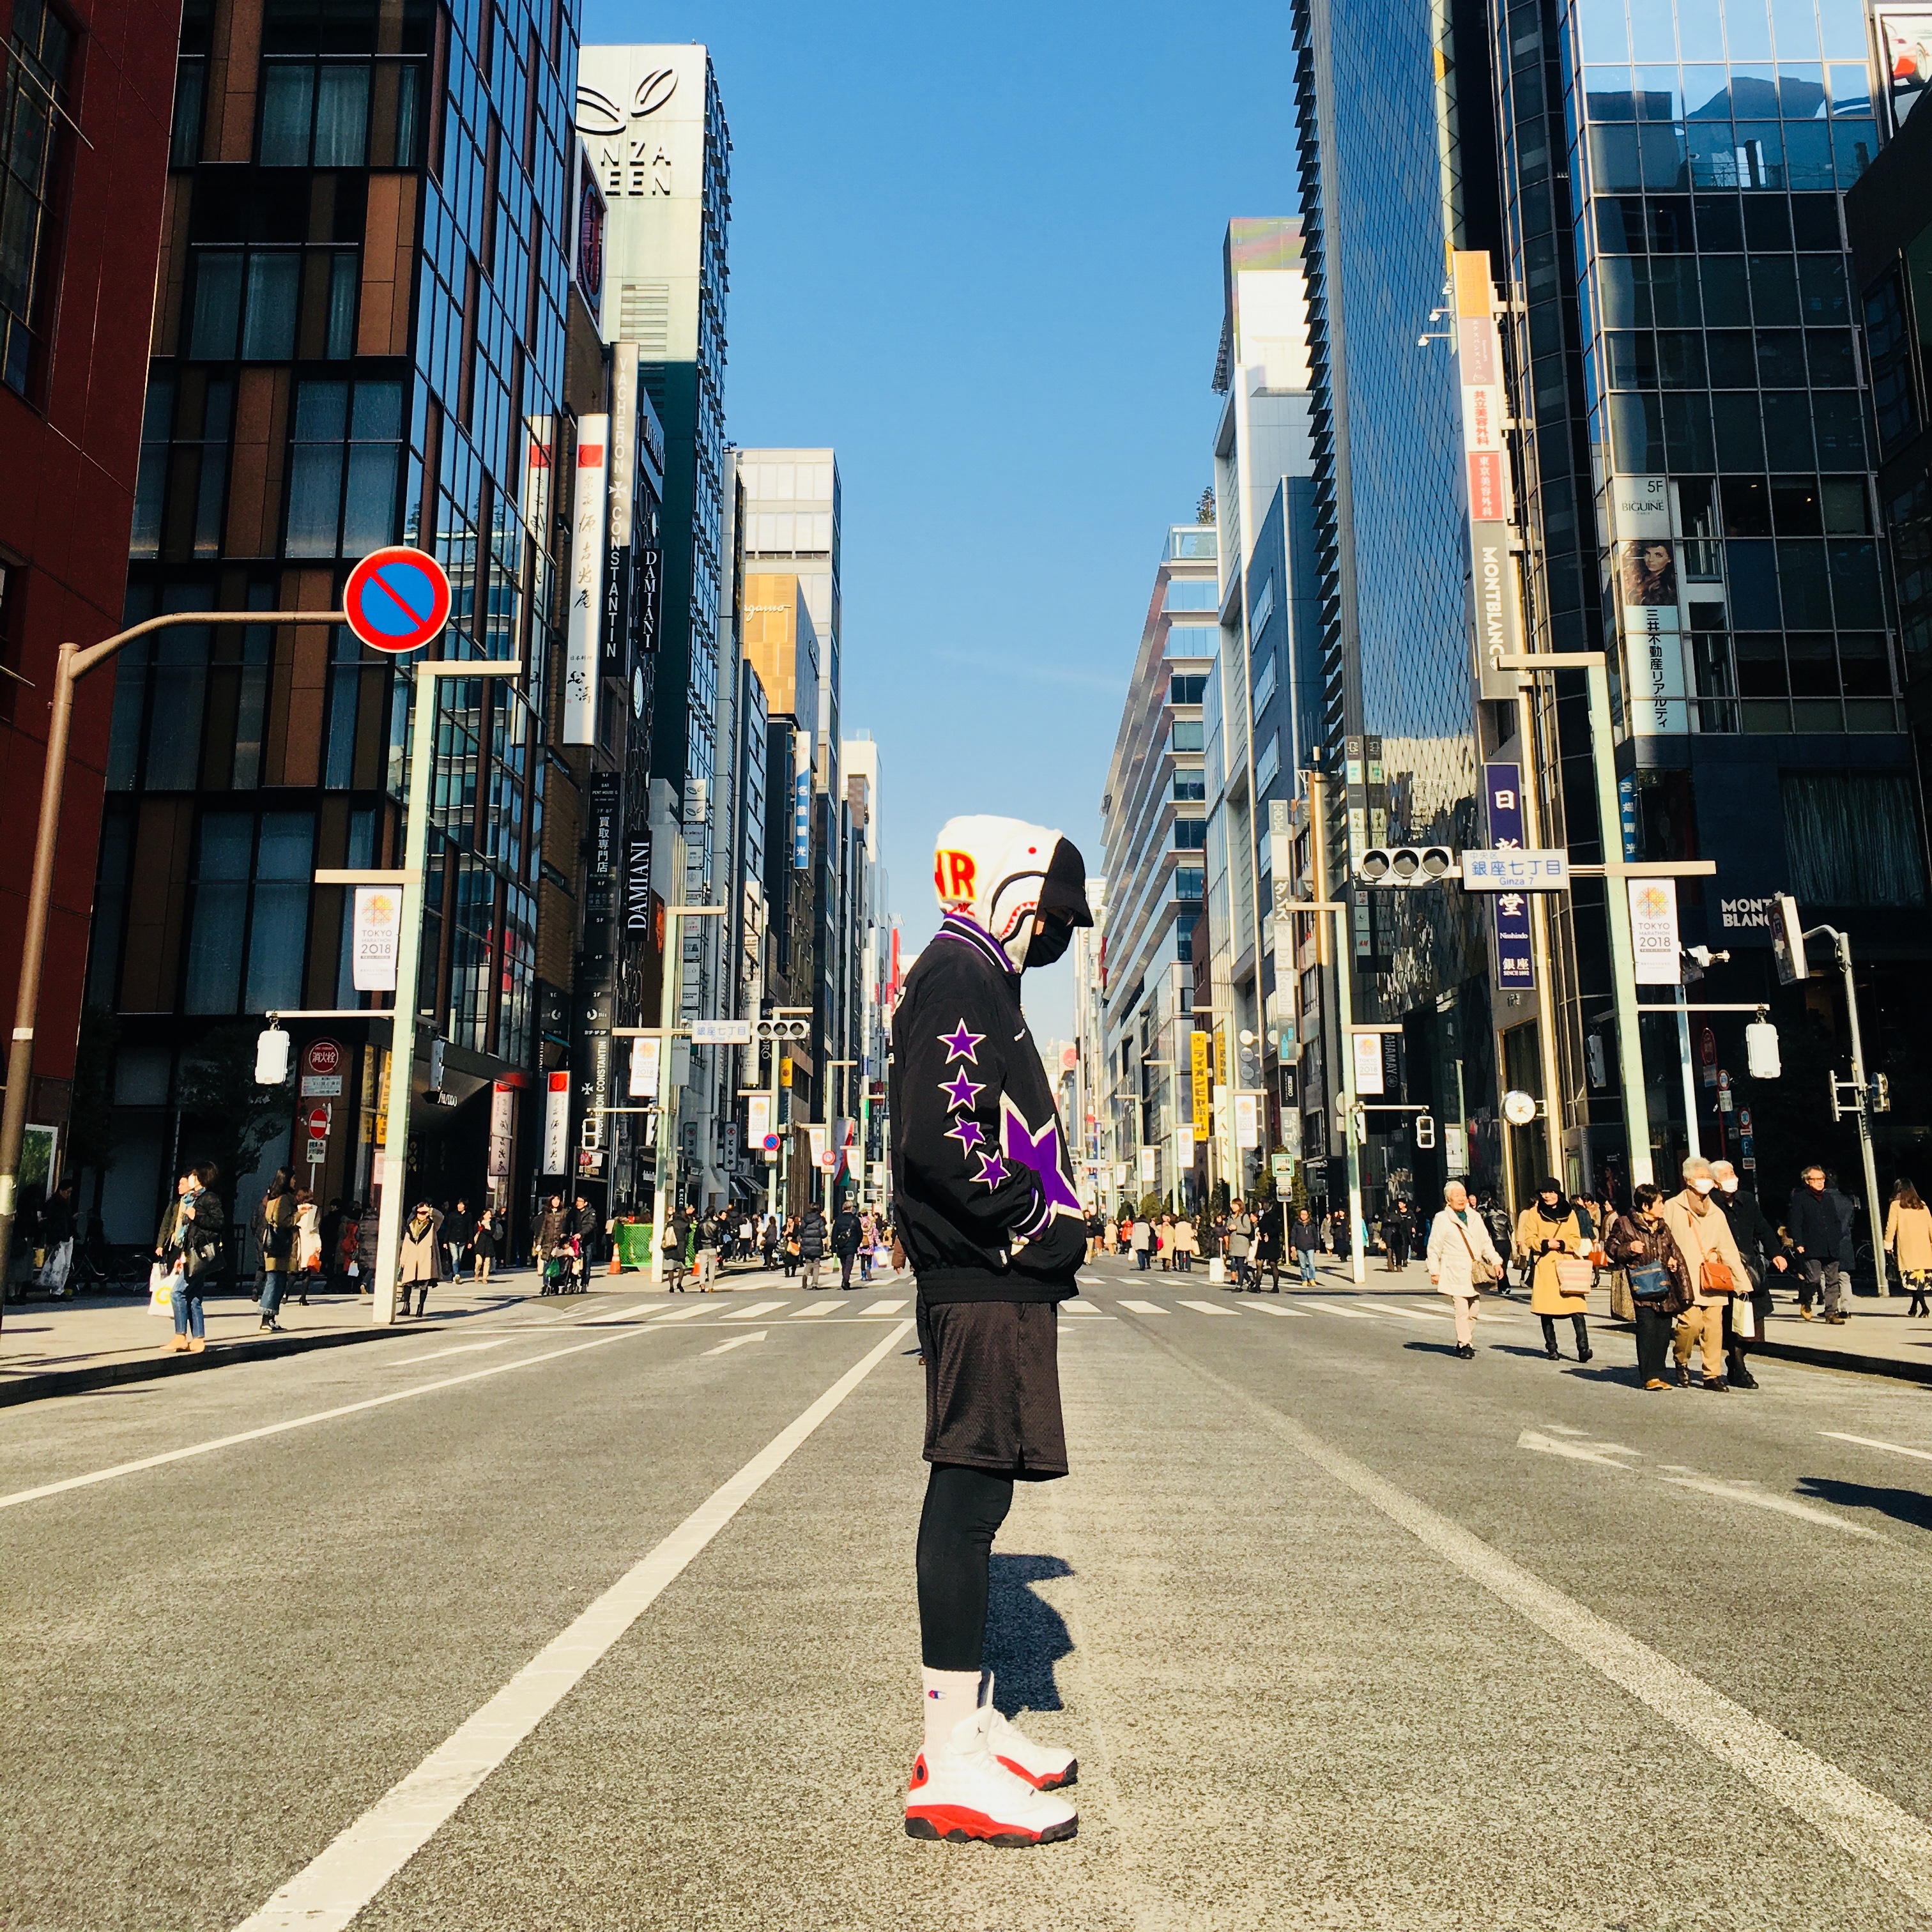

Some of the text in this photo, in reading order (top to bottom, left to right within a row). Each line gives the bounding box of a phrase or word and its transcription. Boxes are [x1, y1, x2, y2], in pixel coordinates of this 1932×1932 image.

[1474, 390, 1489, 445] 共立美容外科
[606, 357, 628, 657] VACHERON CONSTANTIN
[1479, 456, 1492, 517] 東京美容外科
[1622, 502, 1664, 511] BIGUINE
[1648, 480, 1663, 493] 5F
[643, 551, 657, 648] DAMIANI
[1482, 547, 1505, 656] MONTBLANC
[1646, 609, 1667, 728] 三井不動産リアルティ
[597, 816, 610, 873] 買取専門店
[797, 785, 808, 857] 名鉄観光
[627, 841, 649, 930] DAMIANI
[1471, 860, 1560, 875] 銀座七丁目
[1275, 882, 1289, 920] ダンス
[1721, 899, 1772, 912] MONT
[361, 944, 391, 954] 2018
[1503, 958, 1529, 970] 銀座
[1639, 937, 1671, 947] 2018
[1279, 972, 1291, 1013] Recella
[696, 1027, 746, 1036] 銀座七丁目
[312, 1052, 335, 1063] 消火栓
[596, 1041, 606, 1091] CONSTANTIN
[1193, 1050, 1207, 1132] ライオンビヤホール
[1217, 1106, 1229, 1163] ZARA
